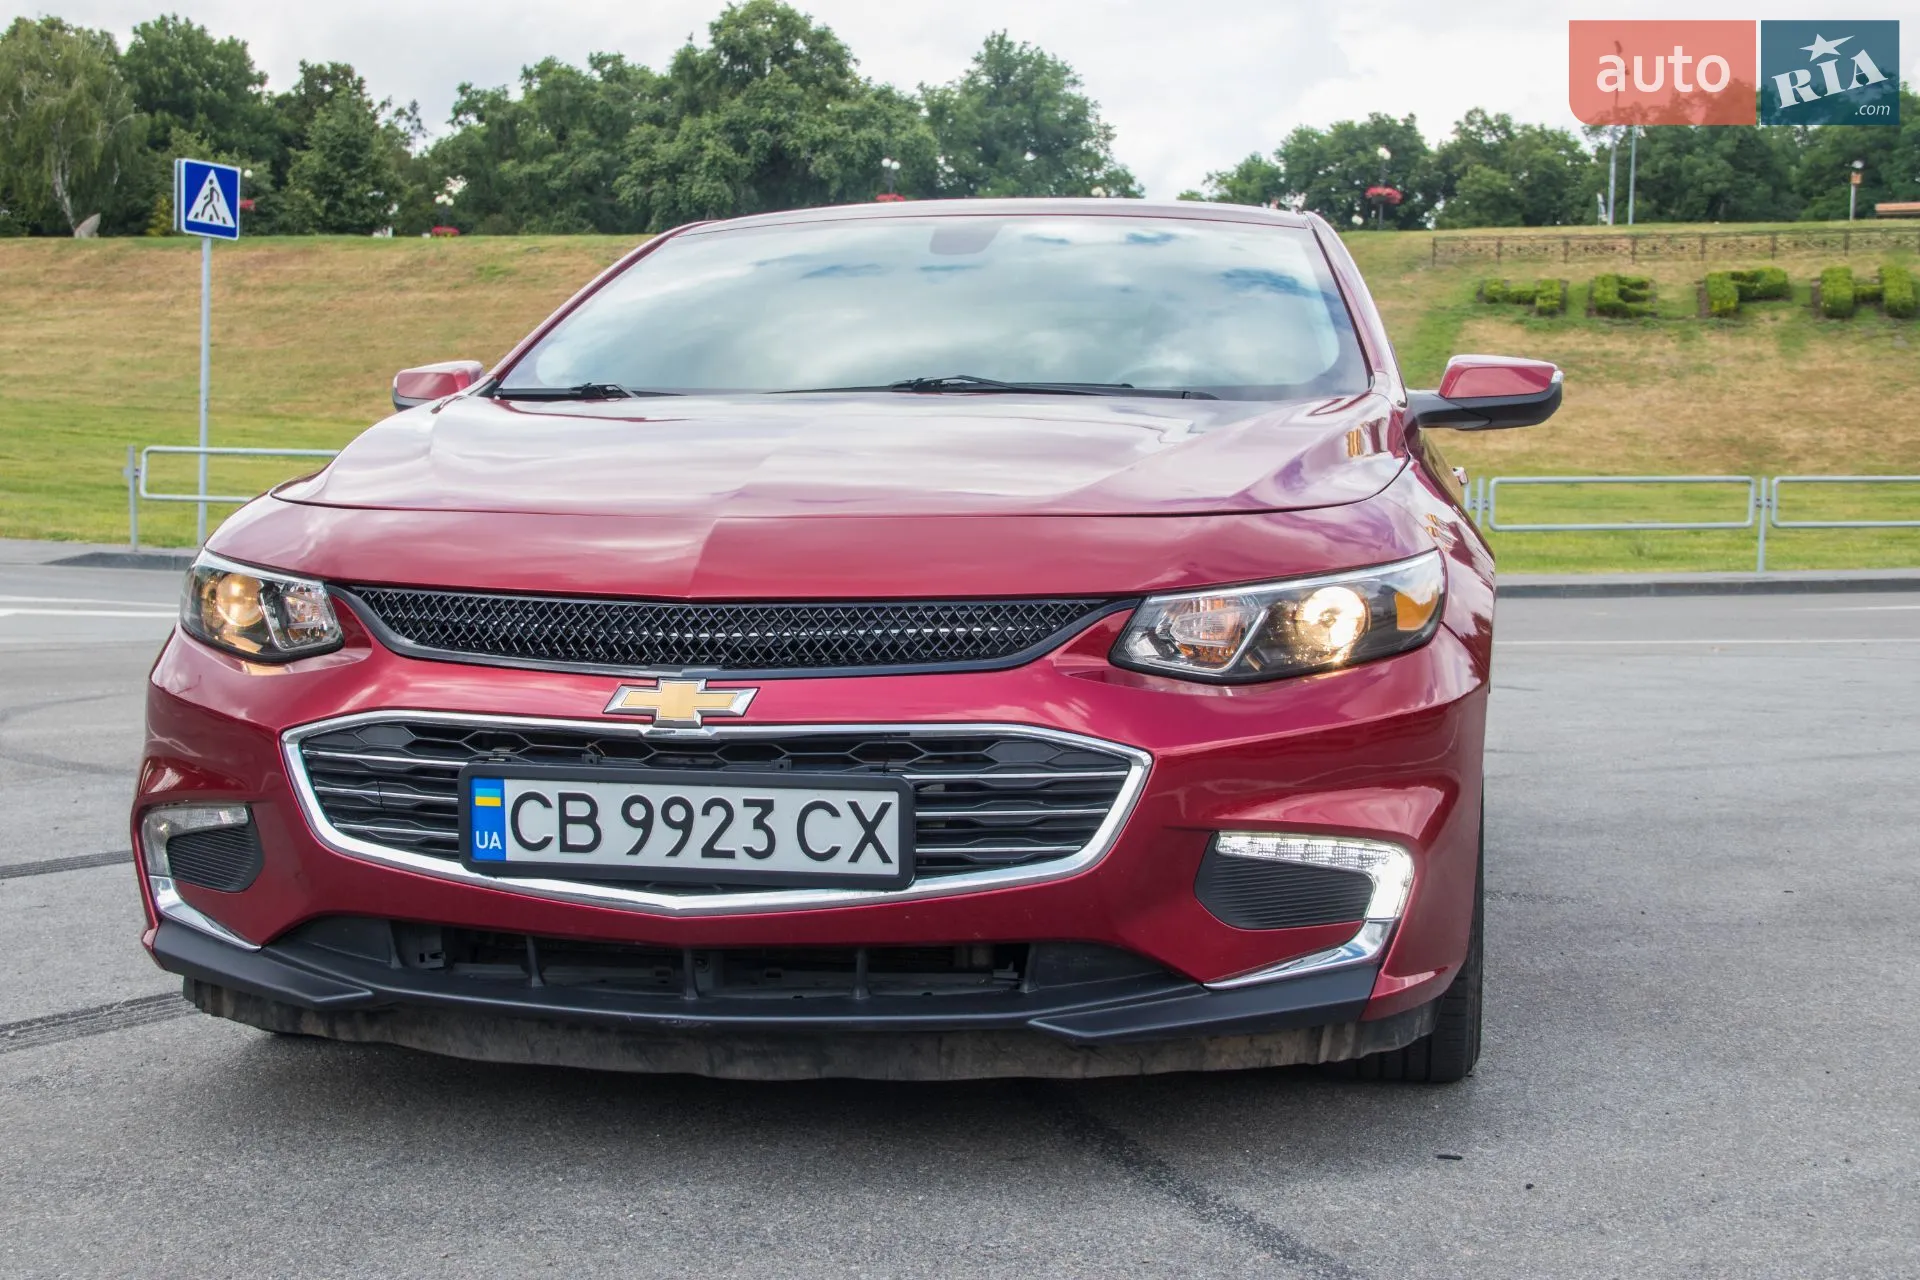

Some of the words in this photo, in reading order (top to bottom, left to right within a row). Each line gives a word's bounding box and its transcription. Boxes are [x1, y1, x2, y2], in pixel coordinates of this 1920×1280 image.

[475, 830, 502, 851] UA
[510, 790, 602, 854] CB
[620, 794, 777, 860] 9923
[796, 800, 894, 864] CX
